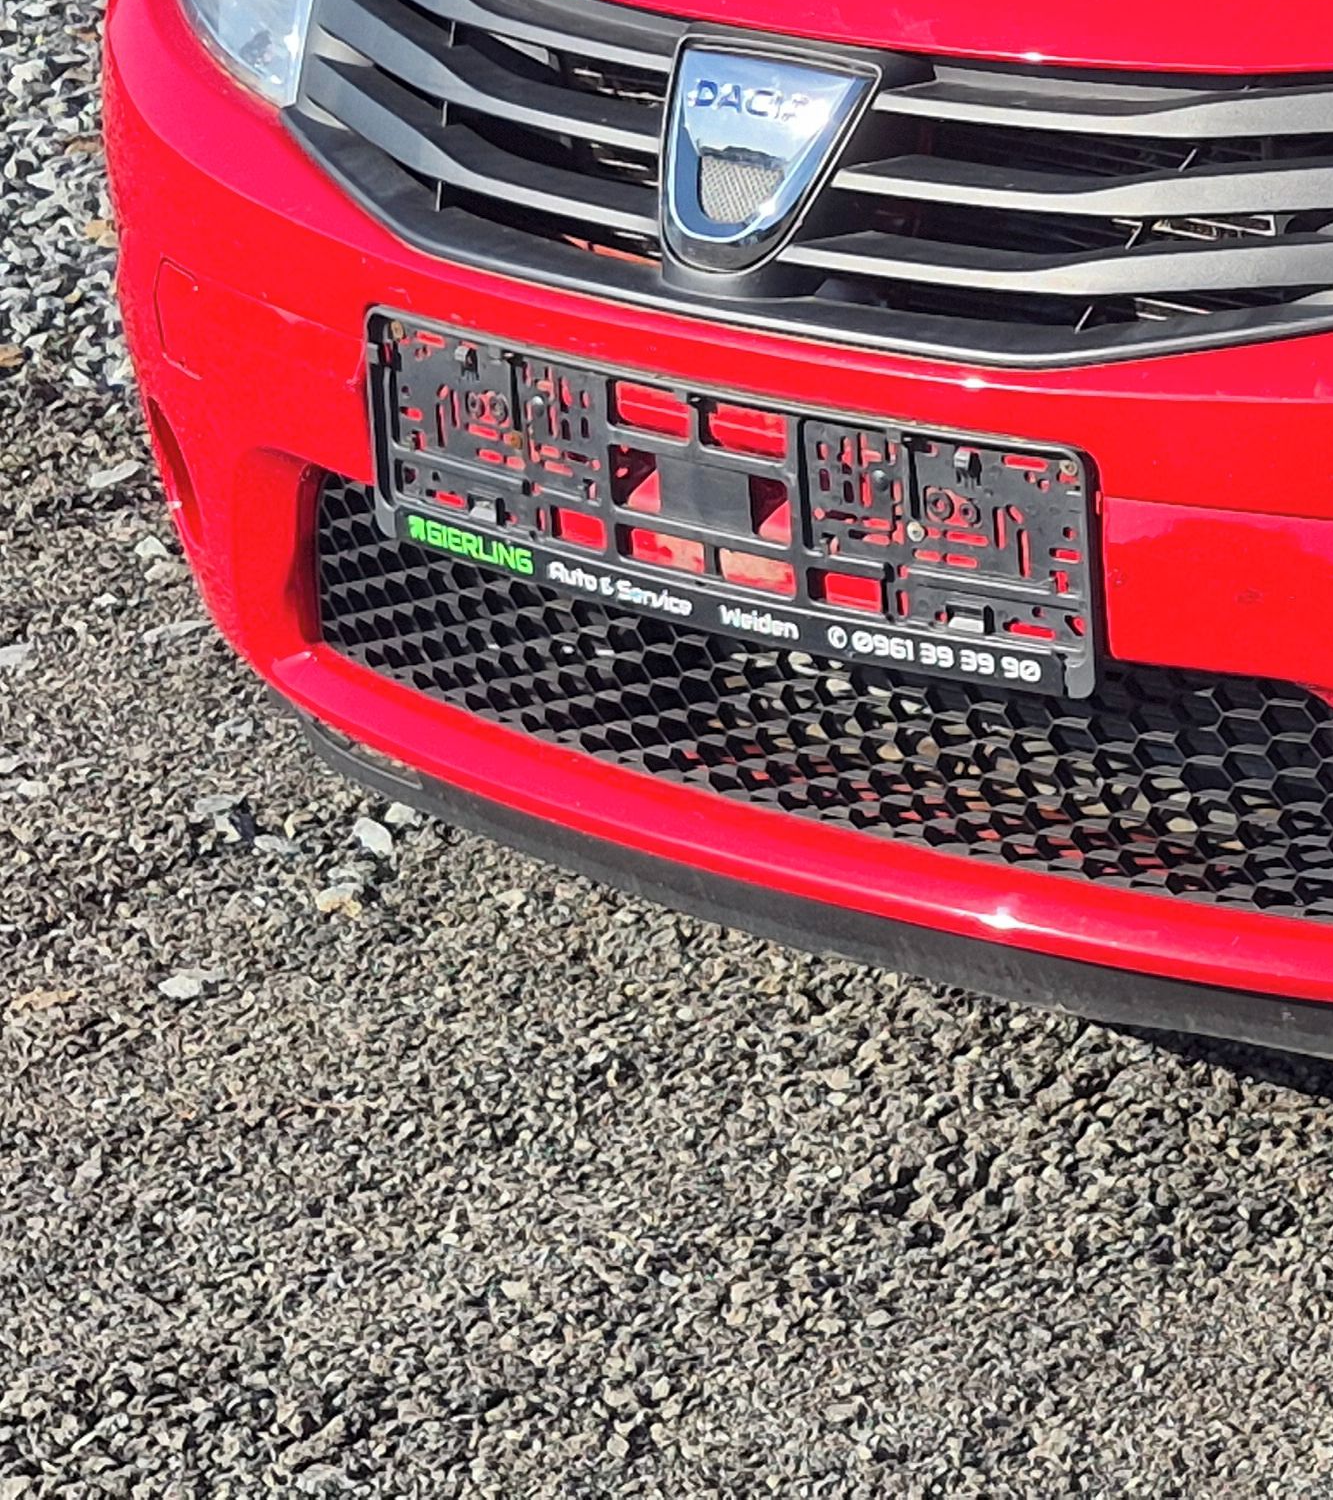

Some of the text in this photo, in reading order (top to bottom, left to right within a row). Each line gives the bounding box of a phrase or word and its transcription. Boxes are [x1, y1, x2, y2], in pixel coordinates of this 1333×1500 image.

[427, 522, 1042, 683] GIERLING Auto & Service Weiden 0961 39 39 90
